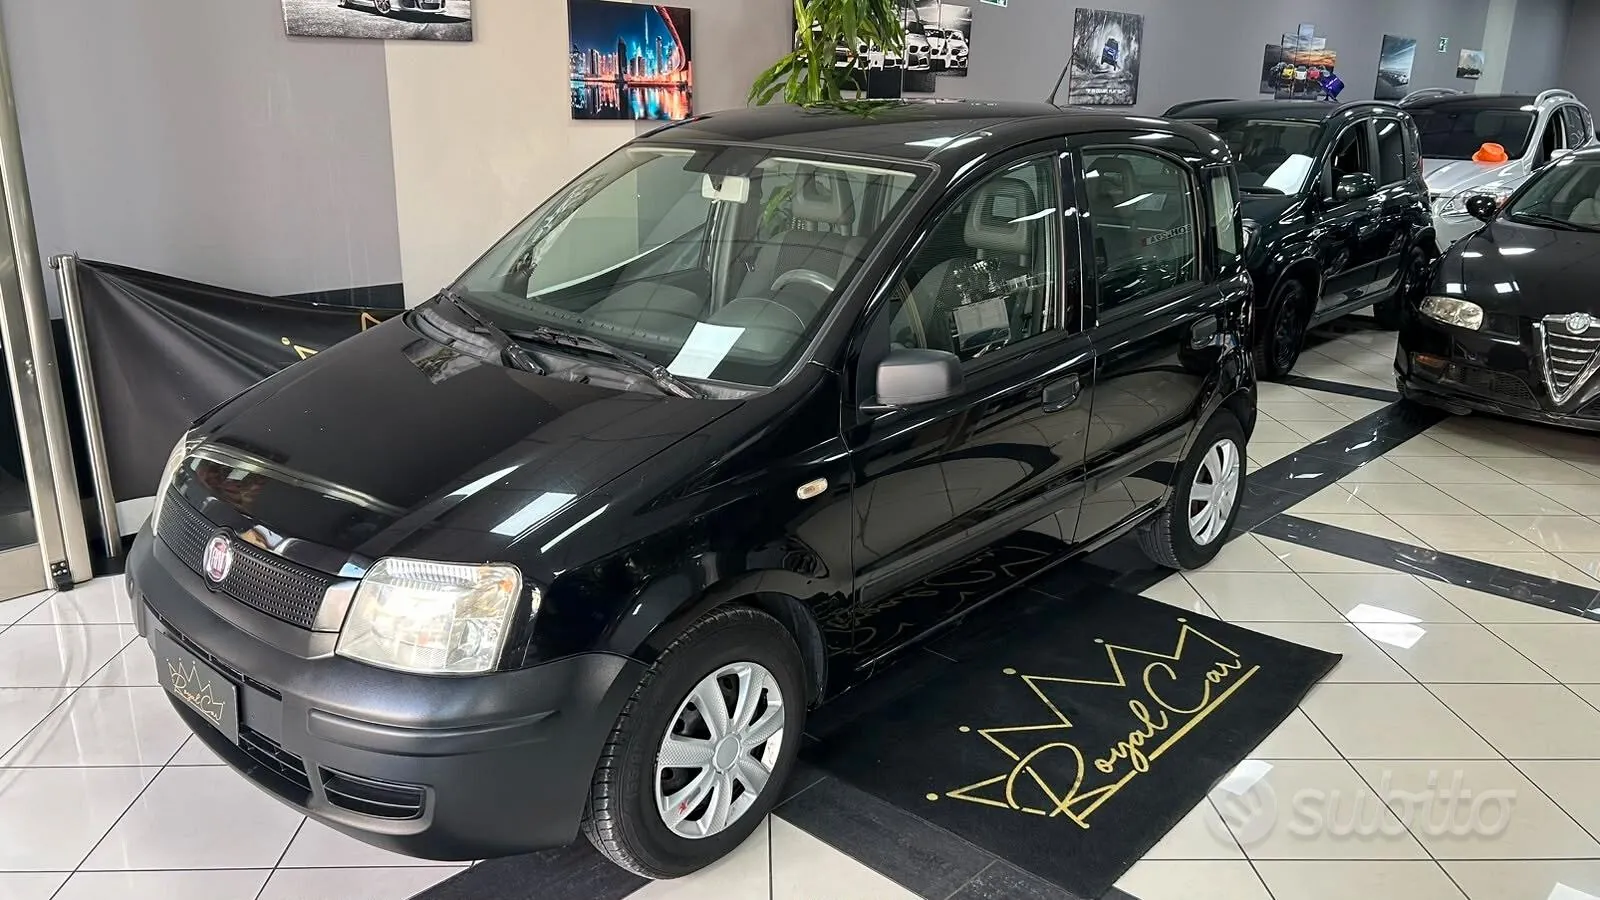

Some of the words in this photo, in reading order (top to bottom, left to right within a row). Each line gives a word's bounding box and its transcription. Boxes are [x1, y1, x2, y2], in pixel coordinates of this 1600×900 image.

[200, 695, 222, 721] Car
[1005, 699, 1169, 830] Royal
[1142, 658, 1242, 714] Car
